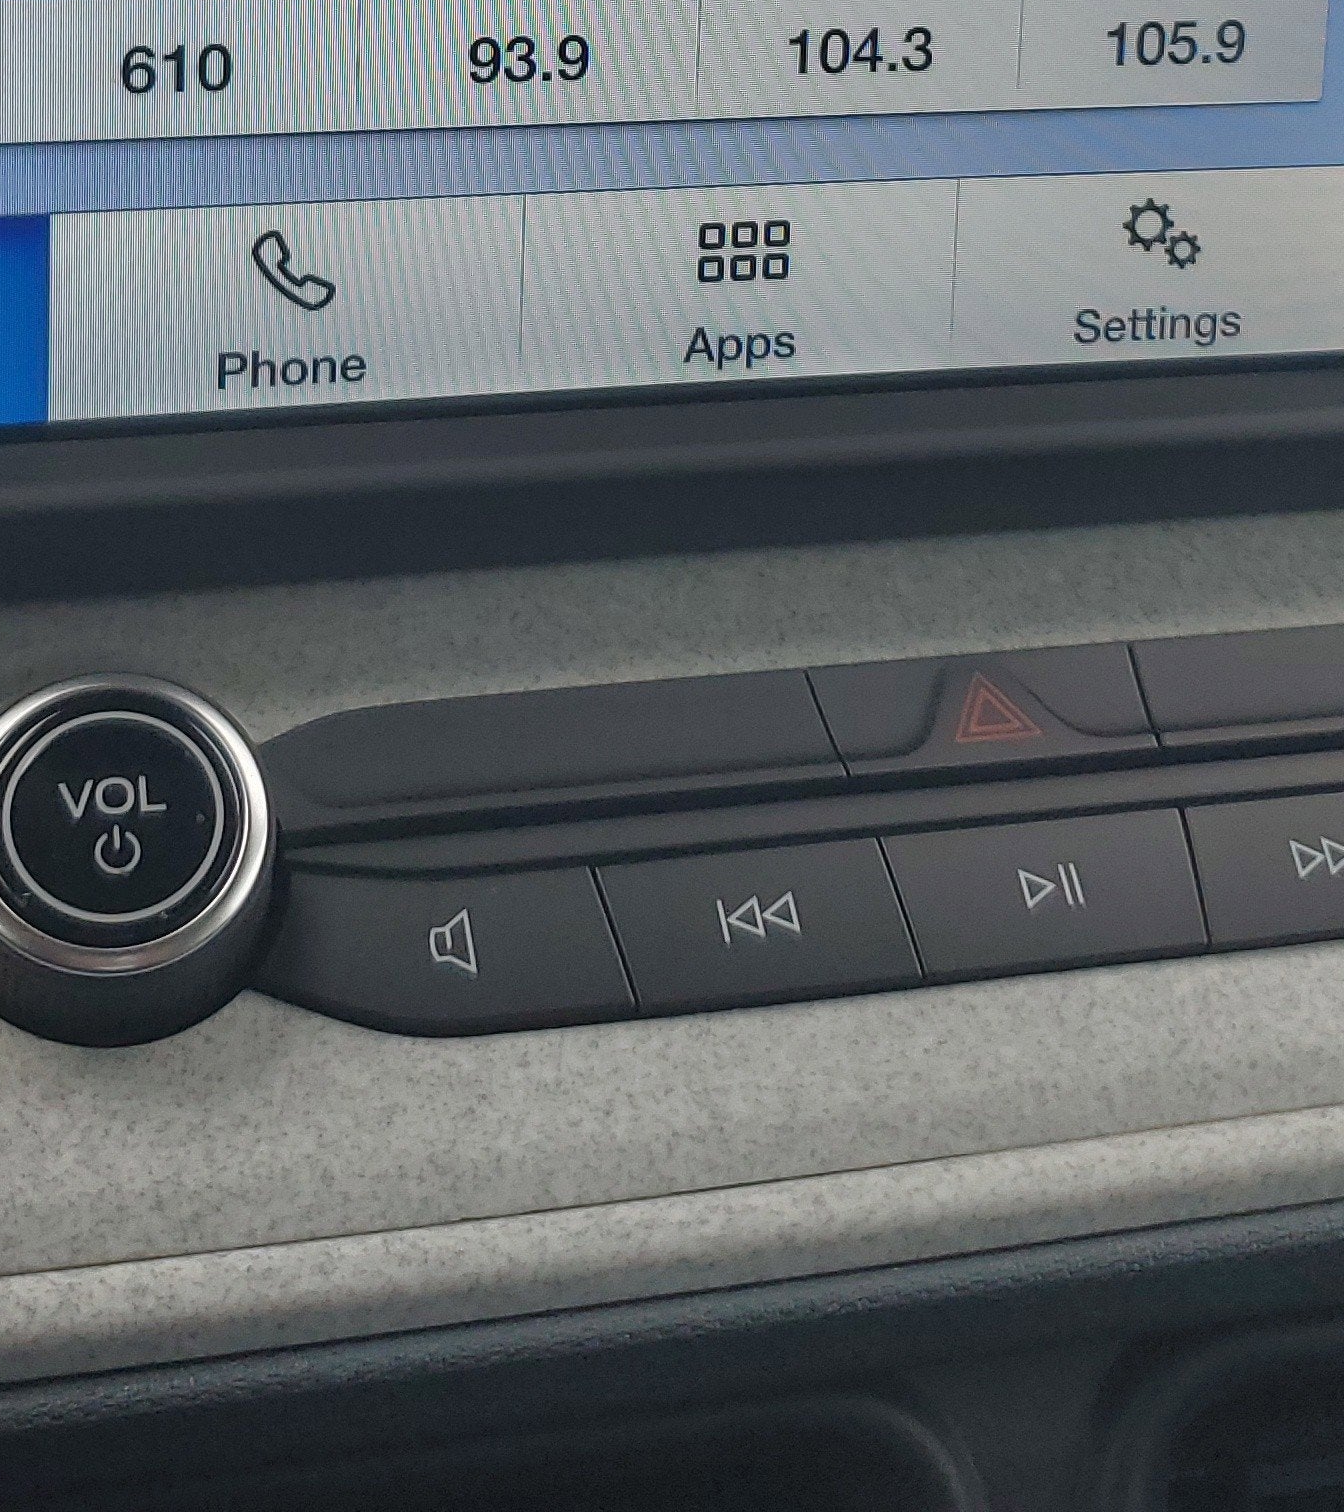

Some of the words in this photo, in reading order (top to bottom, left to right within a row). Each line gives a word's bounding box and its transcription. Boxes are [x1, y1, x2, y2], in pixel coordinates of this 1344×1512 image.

[467, 34, 590, 84] 93.9
[787, 26, 934, 75] 104.3
[1105, 19, 1246, 67] 105.9
[121, 43, 232, 94] 610
[683, 326, 796, 369] Apps
[1072, 305, 1242, 350] Settings
[217, 350, 368, 390] Phone
[58, 776, 166, 820] VOL
